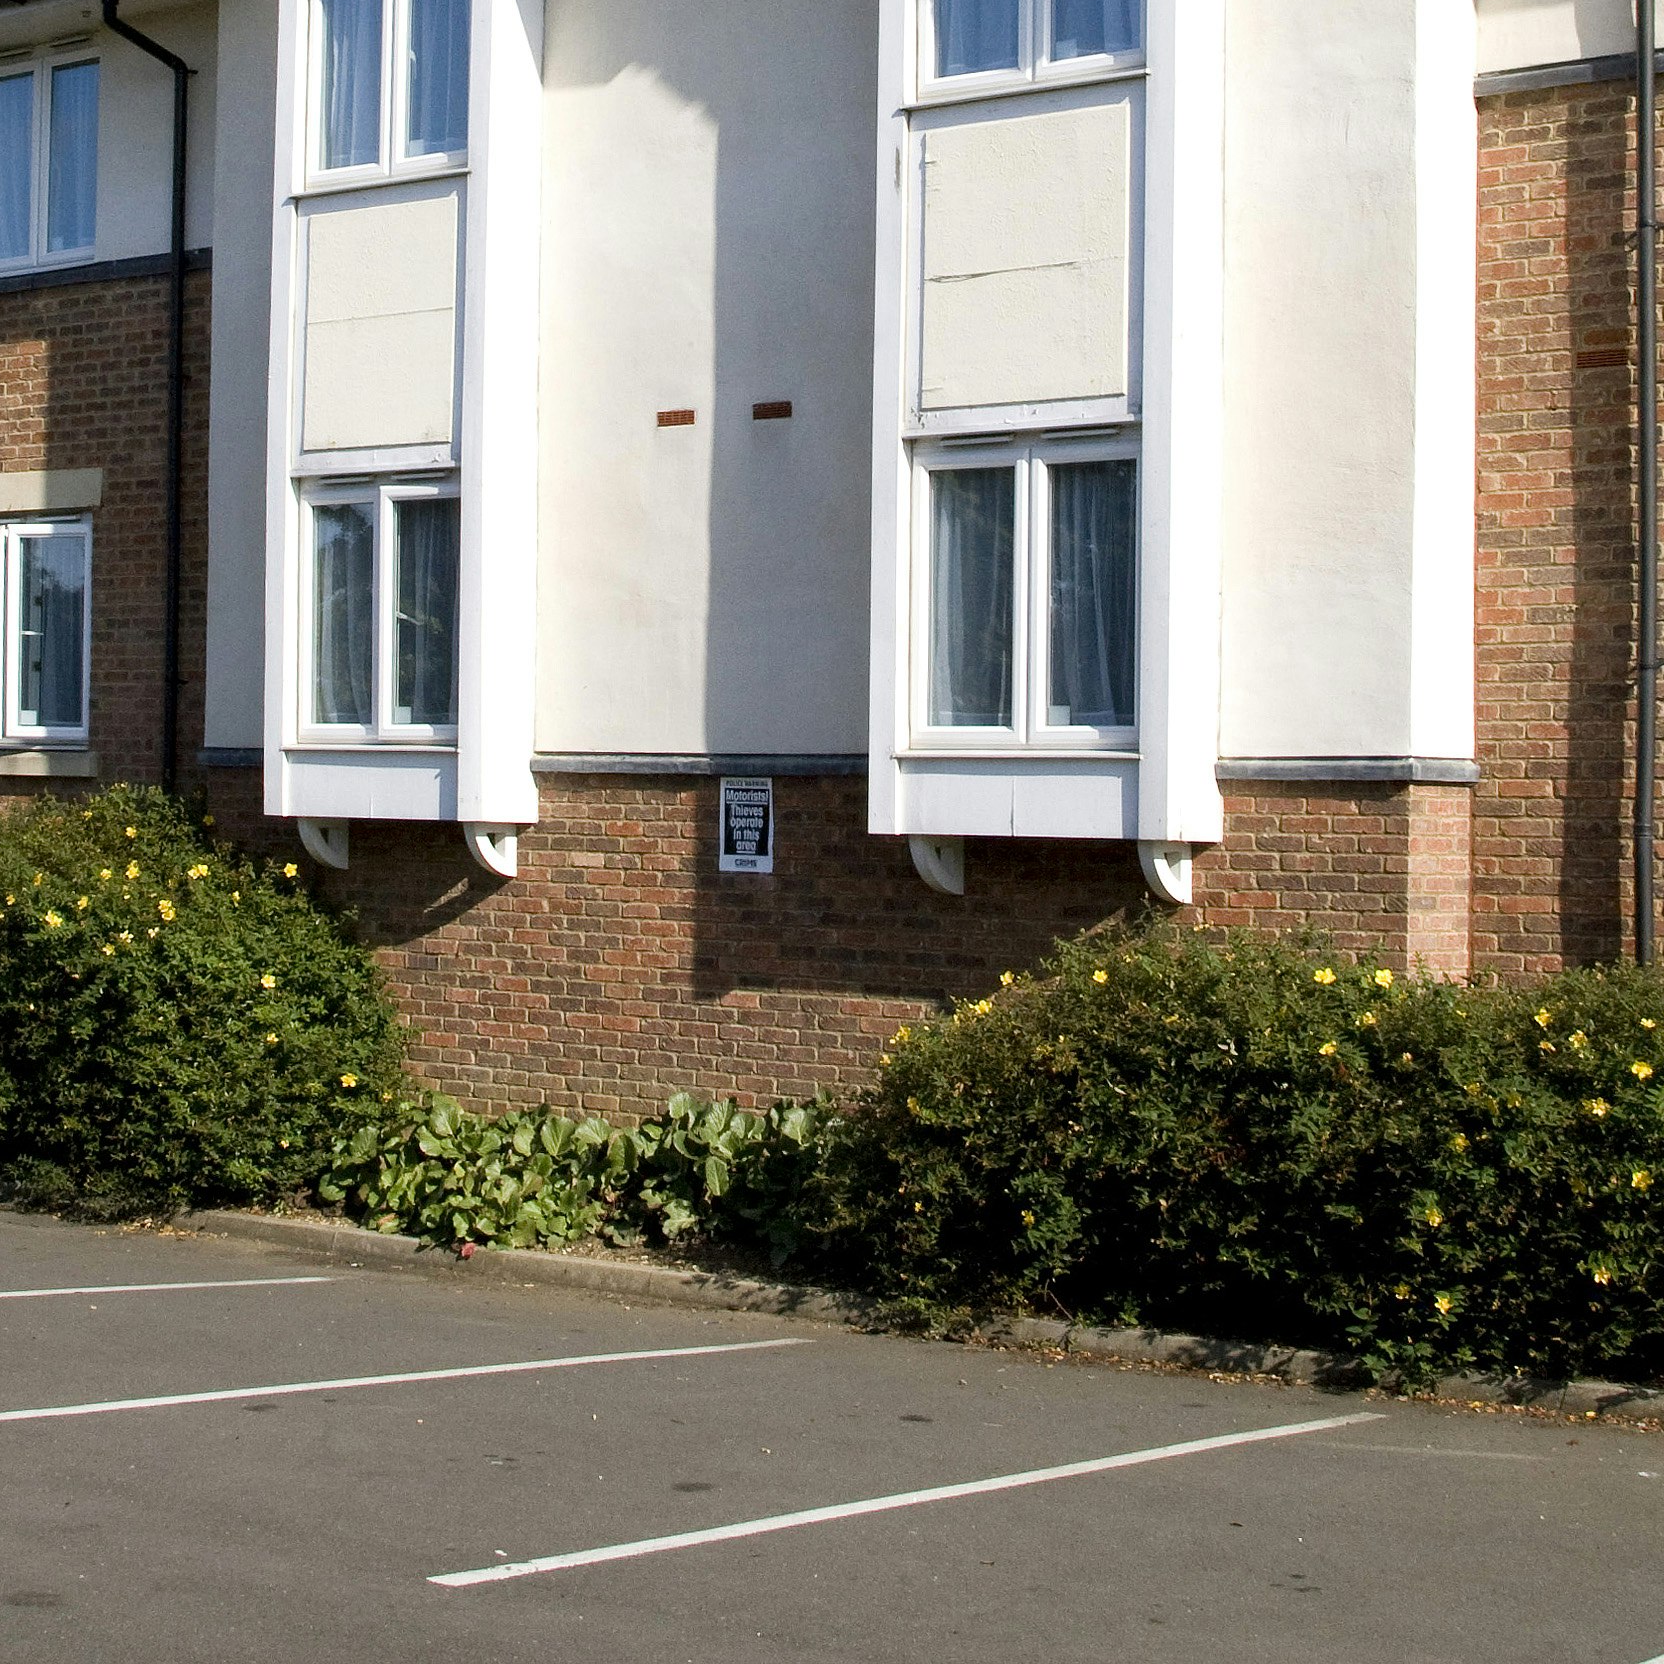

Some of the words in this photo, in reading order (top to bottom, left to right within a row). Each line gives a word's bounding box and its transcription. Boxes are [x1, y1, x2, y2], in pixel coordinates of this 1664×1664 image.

[726, 789, 768, 801] Motorists!
[731, 804, 764, 816] Thieves
[730, 817, 764, 829] operate
[733, 828, 742, 840] in
[743, 829, 760, 841] this
[736, 841, 756, 851] area
